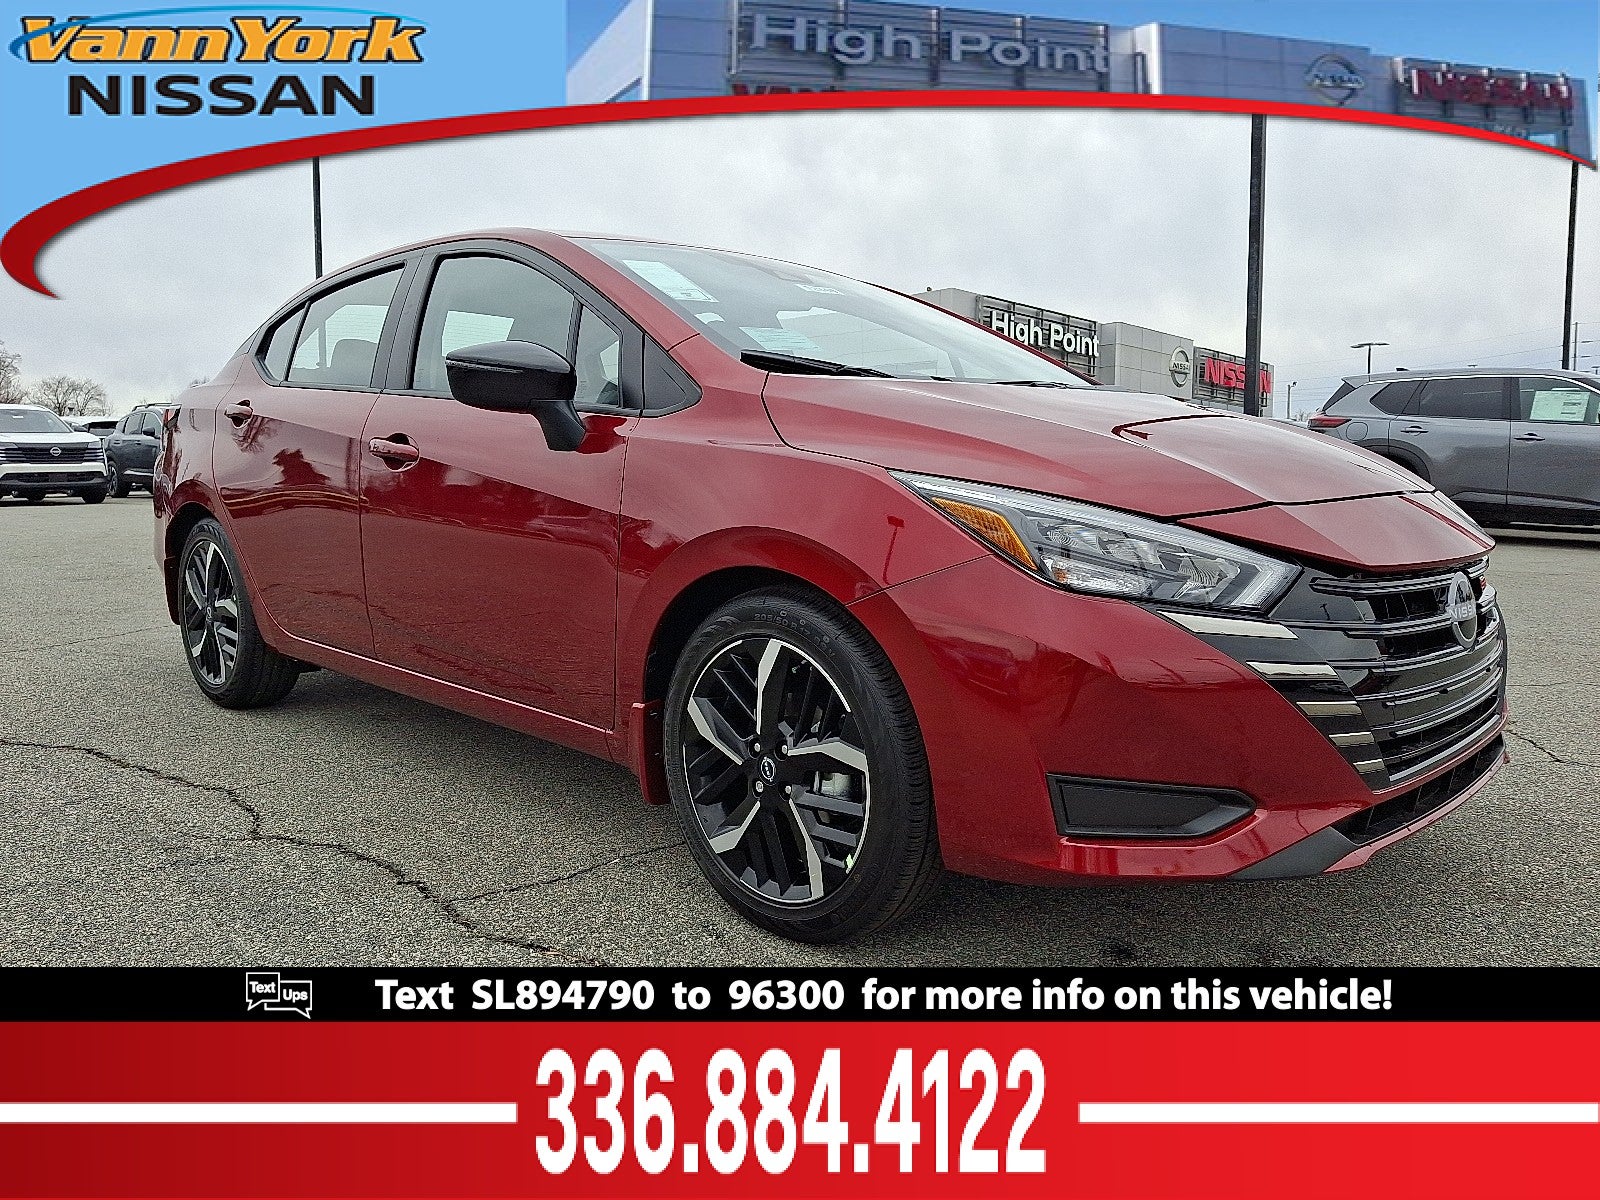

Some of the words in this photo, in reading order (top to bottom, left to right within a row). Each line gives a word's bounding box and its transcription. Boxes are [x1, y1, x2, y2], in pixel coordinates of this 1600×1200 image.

[990, 310, 1044, 346] High
[1050, 322, 1100, 357] Point
[1205, 357, 1272, 394] NISSN
